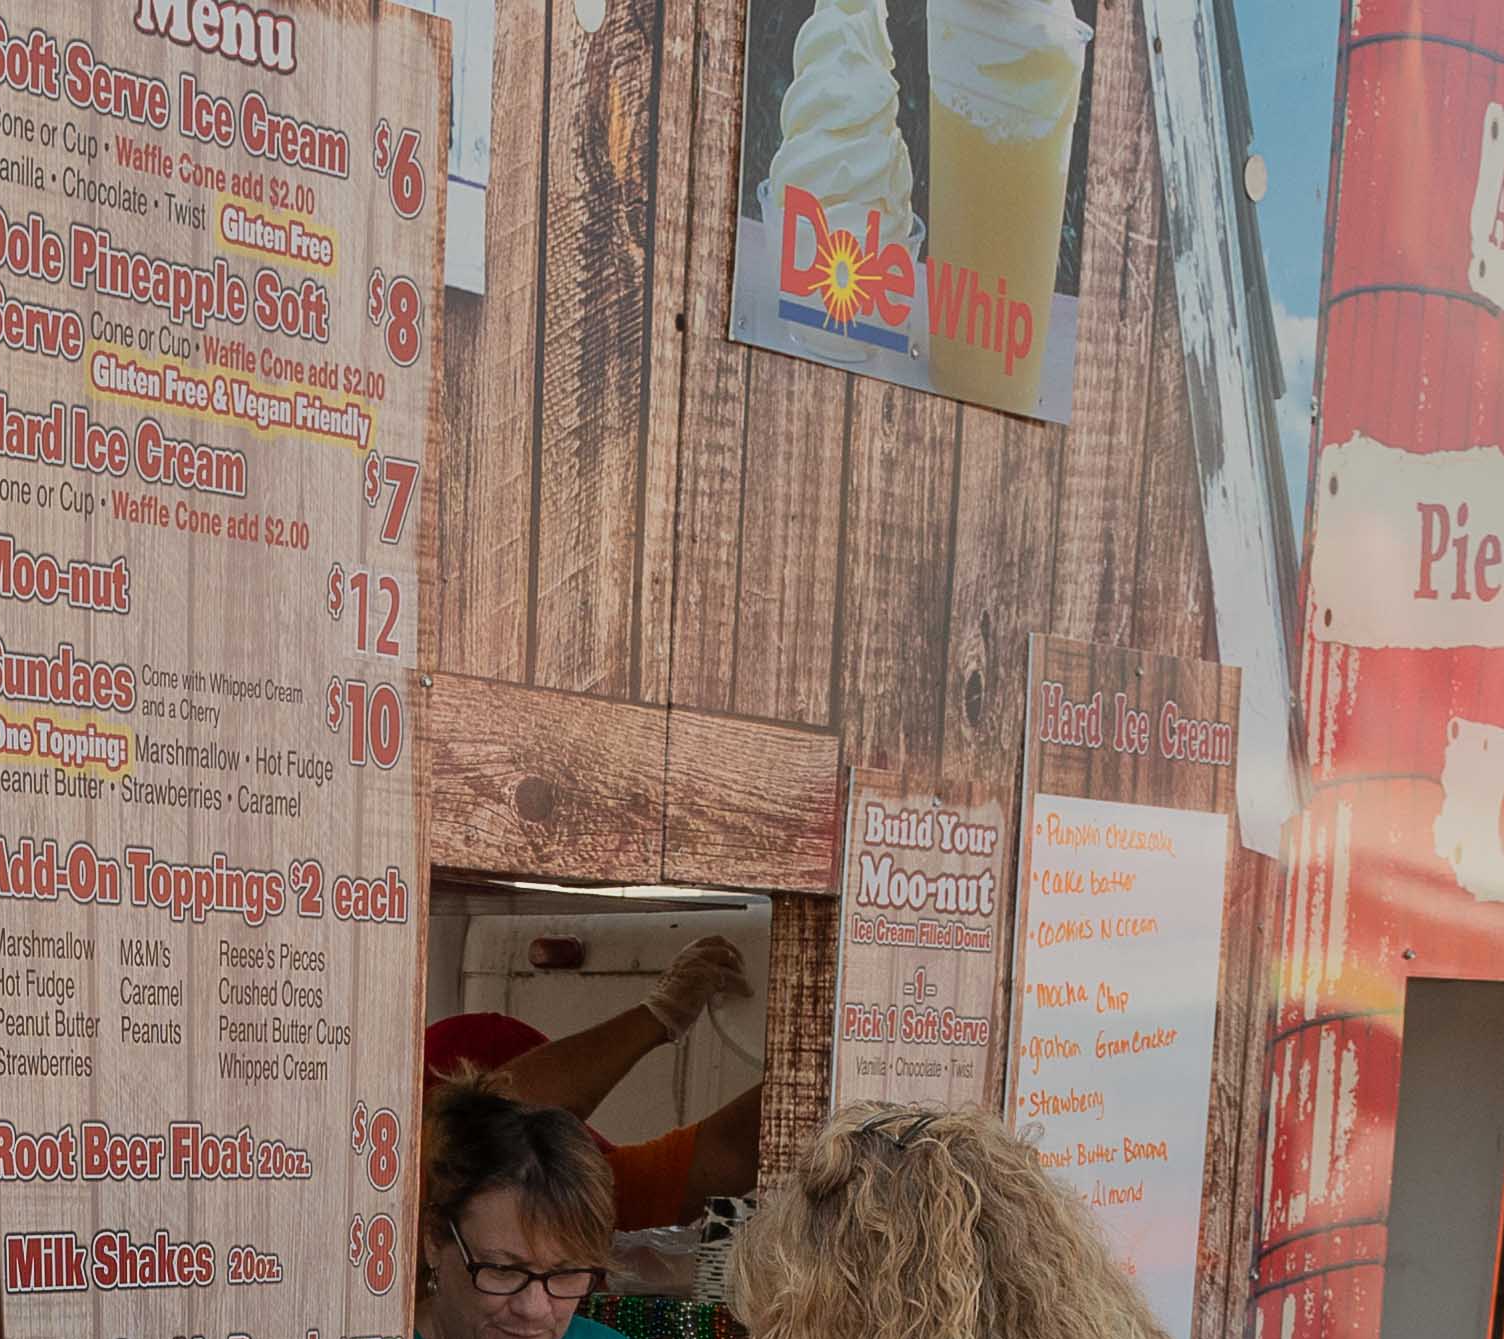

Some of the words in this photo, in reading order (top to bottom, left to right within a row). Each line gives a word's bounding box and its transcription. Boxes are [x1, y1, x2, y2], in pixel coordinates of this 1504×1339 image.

[135, 0, 295, 74] Menu
[64, 41, 168, 130] Serve
[180, 72, 234, 145] Ice
[240, 92, 349, 178] Cream
[374, 119, 425, 219] $6
[70, 224, 246, 327] Pineapple
[253, 270, 330, 342] Soft
[369, 269, 420, 365] $8
[780, 184, 916, 327] Dole
[925, 255, 1033, 376] Whip
[1417, 502, 1503, 603] Pie
[327, 562, 401, 657] $12
[326, 676, 403, 768] $10
[1039, 681, 1102, 749] Hard
[1113, 693, 1149, 754] Ice
[1159, 703, 1231, 765] Cream
[82, 1122, 165, 1180] Beer
[170, 1121, 254, 1180] Float
[257, 1146, 312, 1179] 20oz.
[6, 1233, 88, 1293] Milk
[92, 1230, 214, 1289] Shakes
